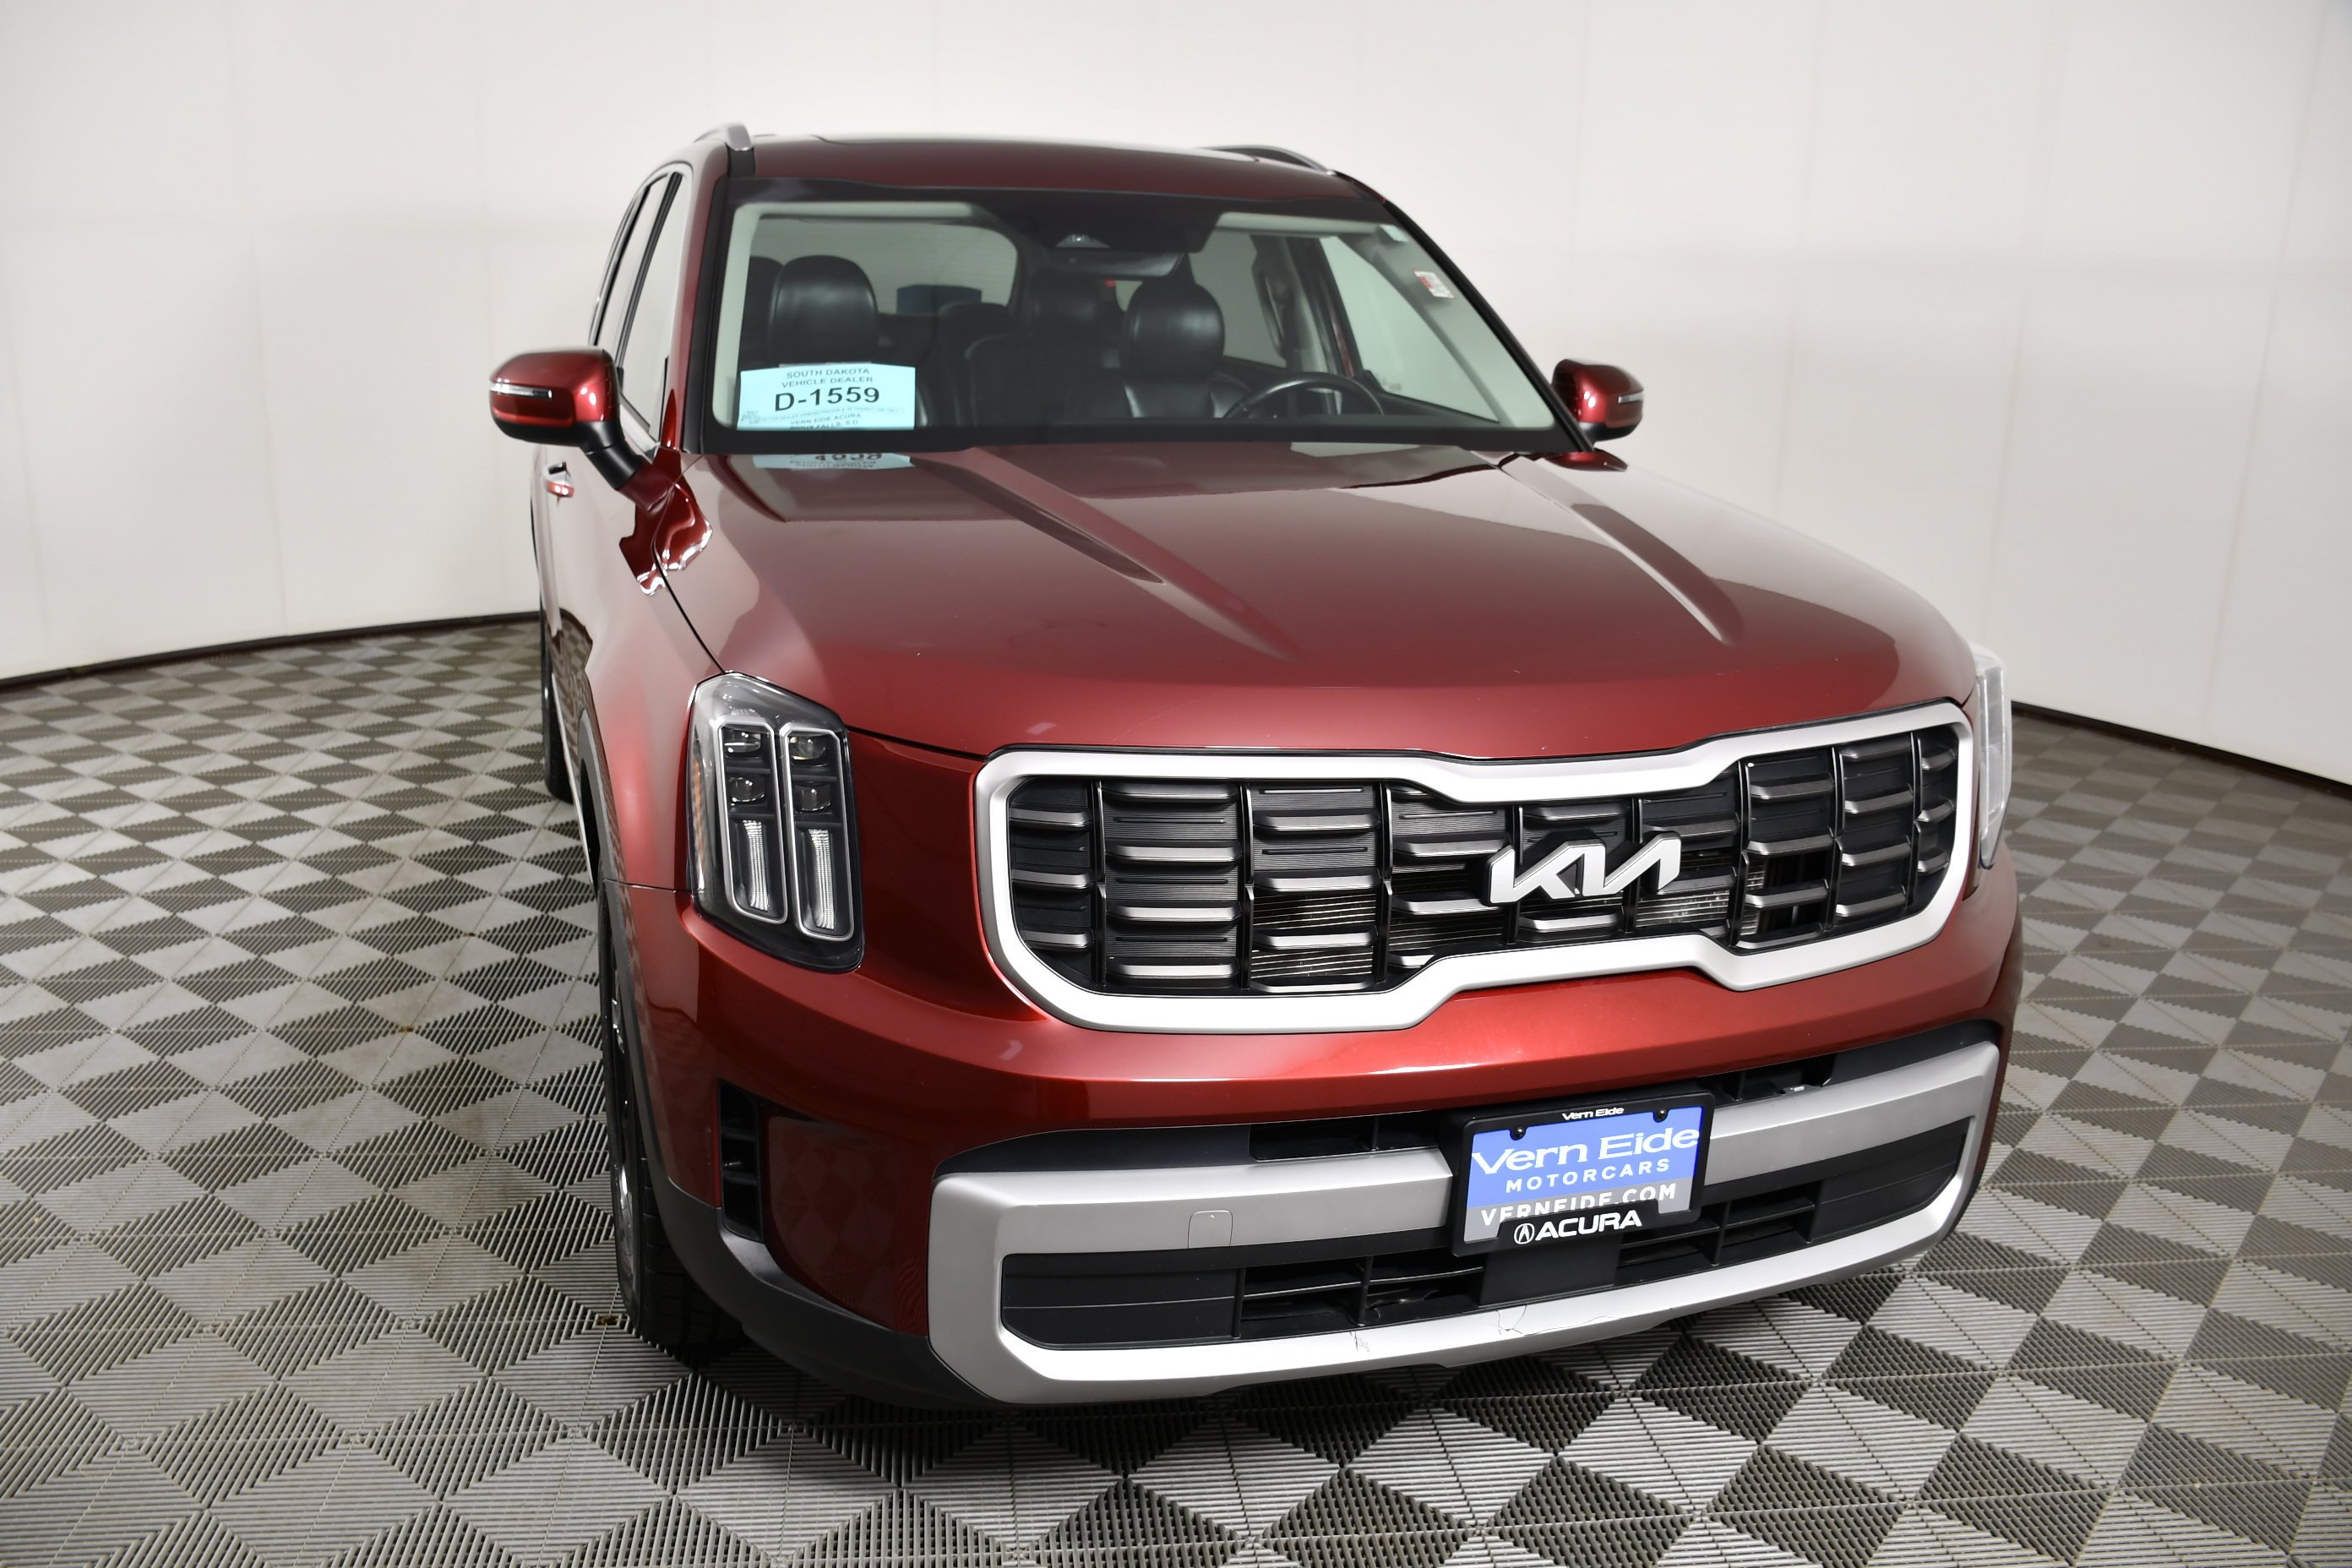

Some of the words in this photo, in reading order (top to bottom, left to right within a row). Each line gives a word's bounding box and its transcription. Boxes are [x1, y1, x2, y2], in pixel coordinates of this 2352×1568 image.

[782, 378, 826, 388] VEHICLE
[787, 369, 822, 378] SOUTH
[776, 387, 879, 411] D-1559
[1489, 836, 1681, 904] KIA
[1562, 1110, 1594, 1120] Vern
[1596, 1107, 1624, 1118] Eide
[1472, 1141, 1587, 1175] Vern
[1598, 1127, 1700, 1160] Eide
[1505, 1157, 1670, 1194] MOTORCARS
[1534, 1209, 1642, 1241] ACURA
